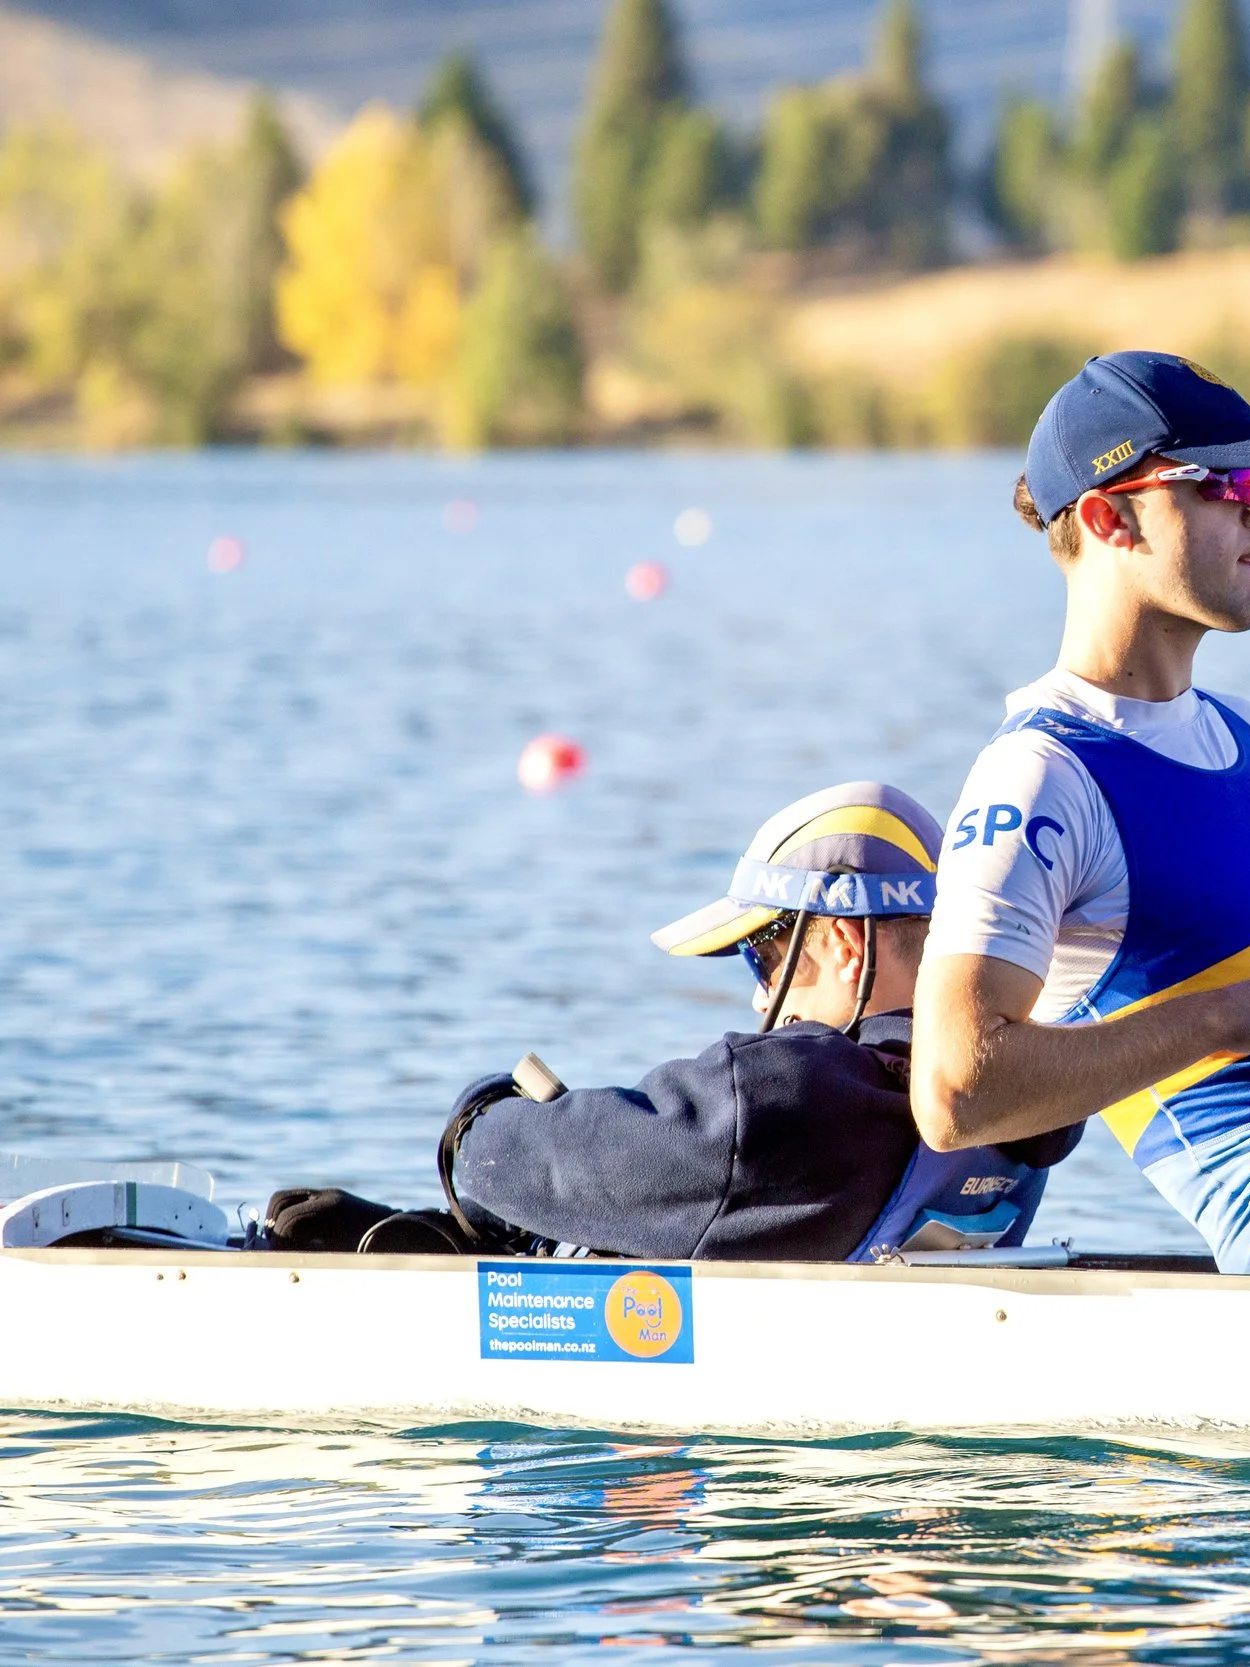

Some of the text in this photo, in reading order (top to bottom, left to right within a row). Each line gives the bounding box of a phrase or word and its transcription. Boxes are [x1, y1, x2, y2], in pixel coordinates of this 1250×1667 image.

[1091, 439, 1136, 475] XXIII
[952, 803, 1065, 871] SPC
[752, 869, 925, 909] NK NK NK
[487, 1271, 523, 1287] Pool
[487, 1291, 595, 1310] Maintenance
[623, 1295, 663, 1319] Pool
[488, 1312, 576, 1331] Specialists
[639, 1327, 668, 1342] Man
[489, 1338, 597, 1354] thepoolman.co.nz
